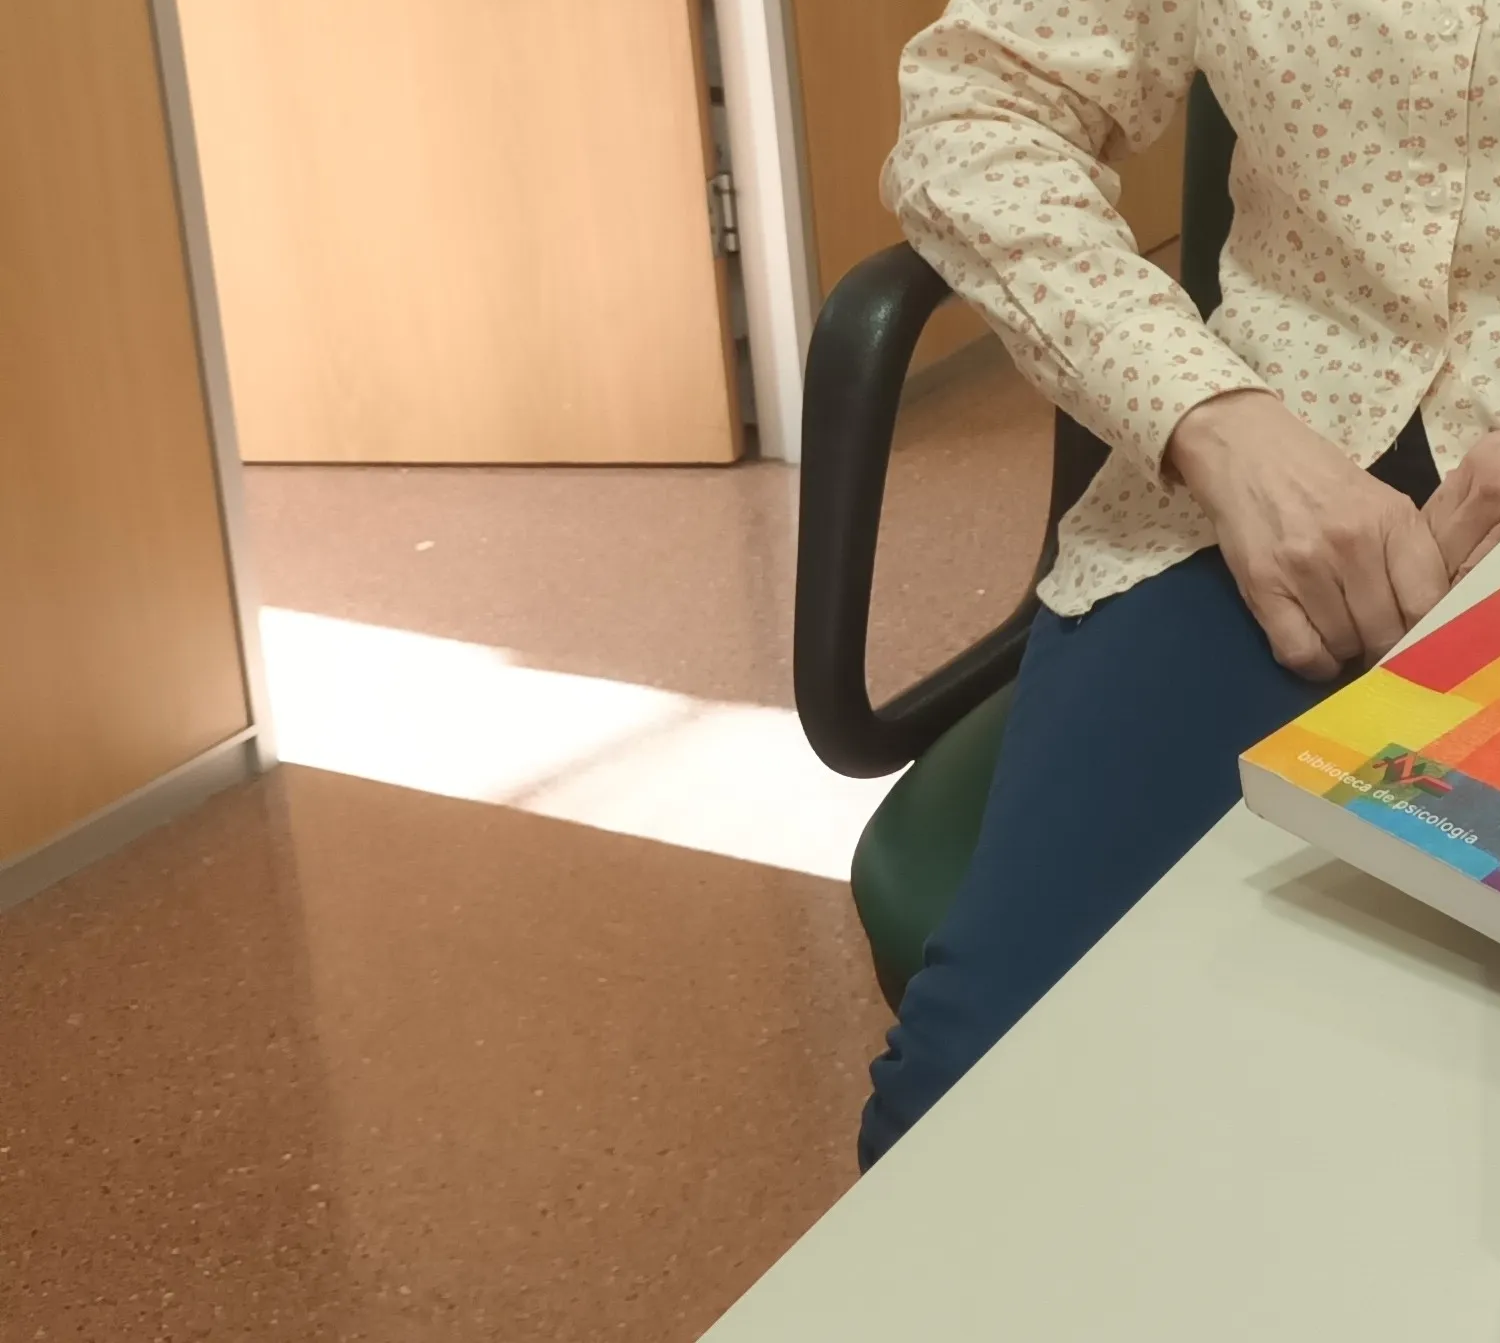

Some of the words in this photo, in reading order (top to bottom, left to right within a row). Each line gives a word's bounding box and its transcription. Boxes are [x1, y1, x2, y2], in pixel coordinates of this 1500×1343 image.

[1297, 750, 1373, 794] biblioteca
[1373, 788, 1395, 804] de
[1392, 797, 1479, 845] psicología
